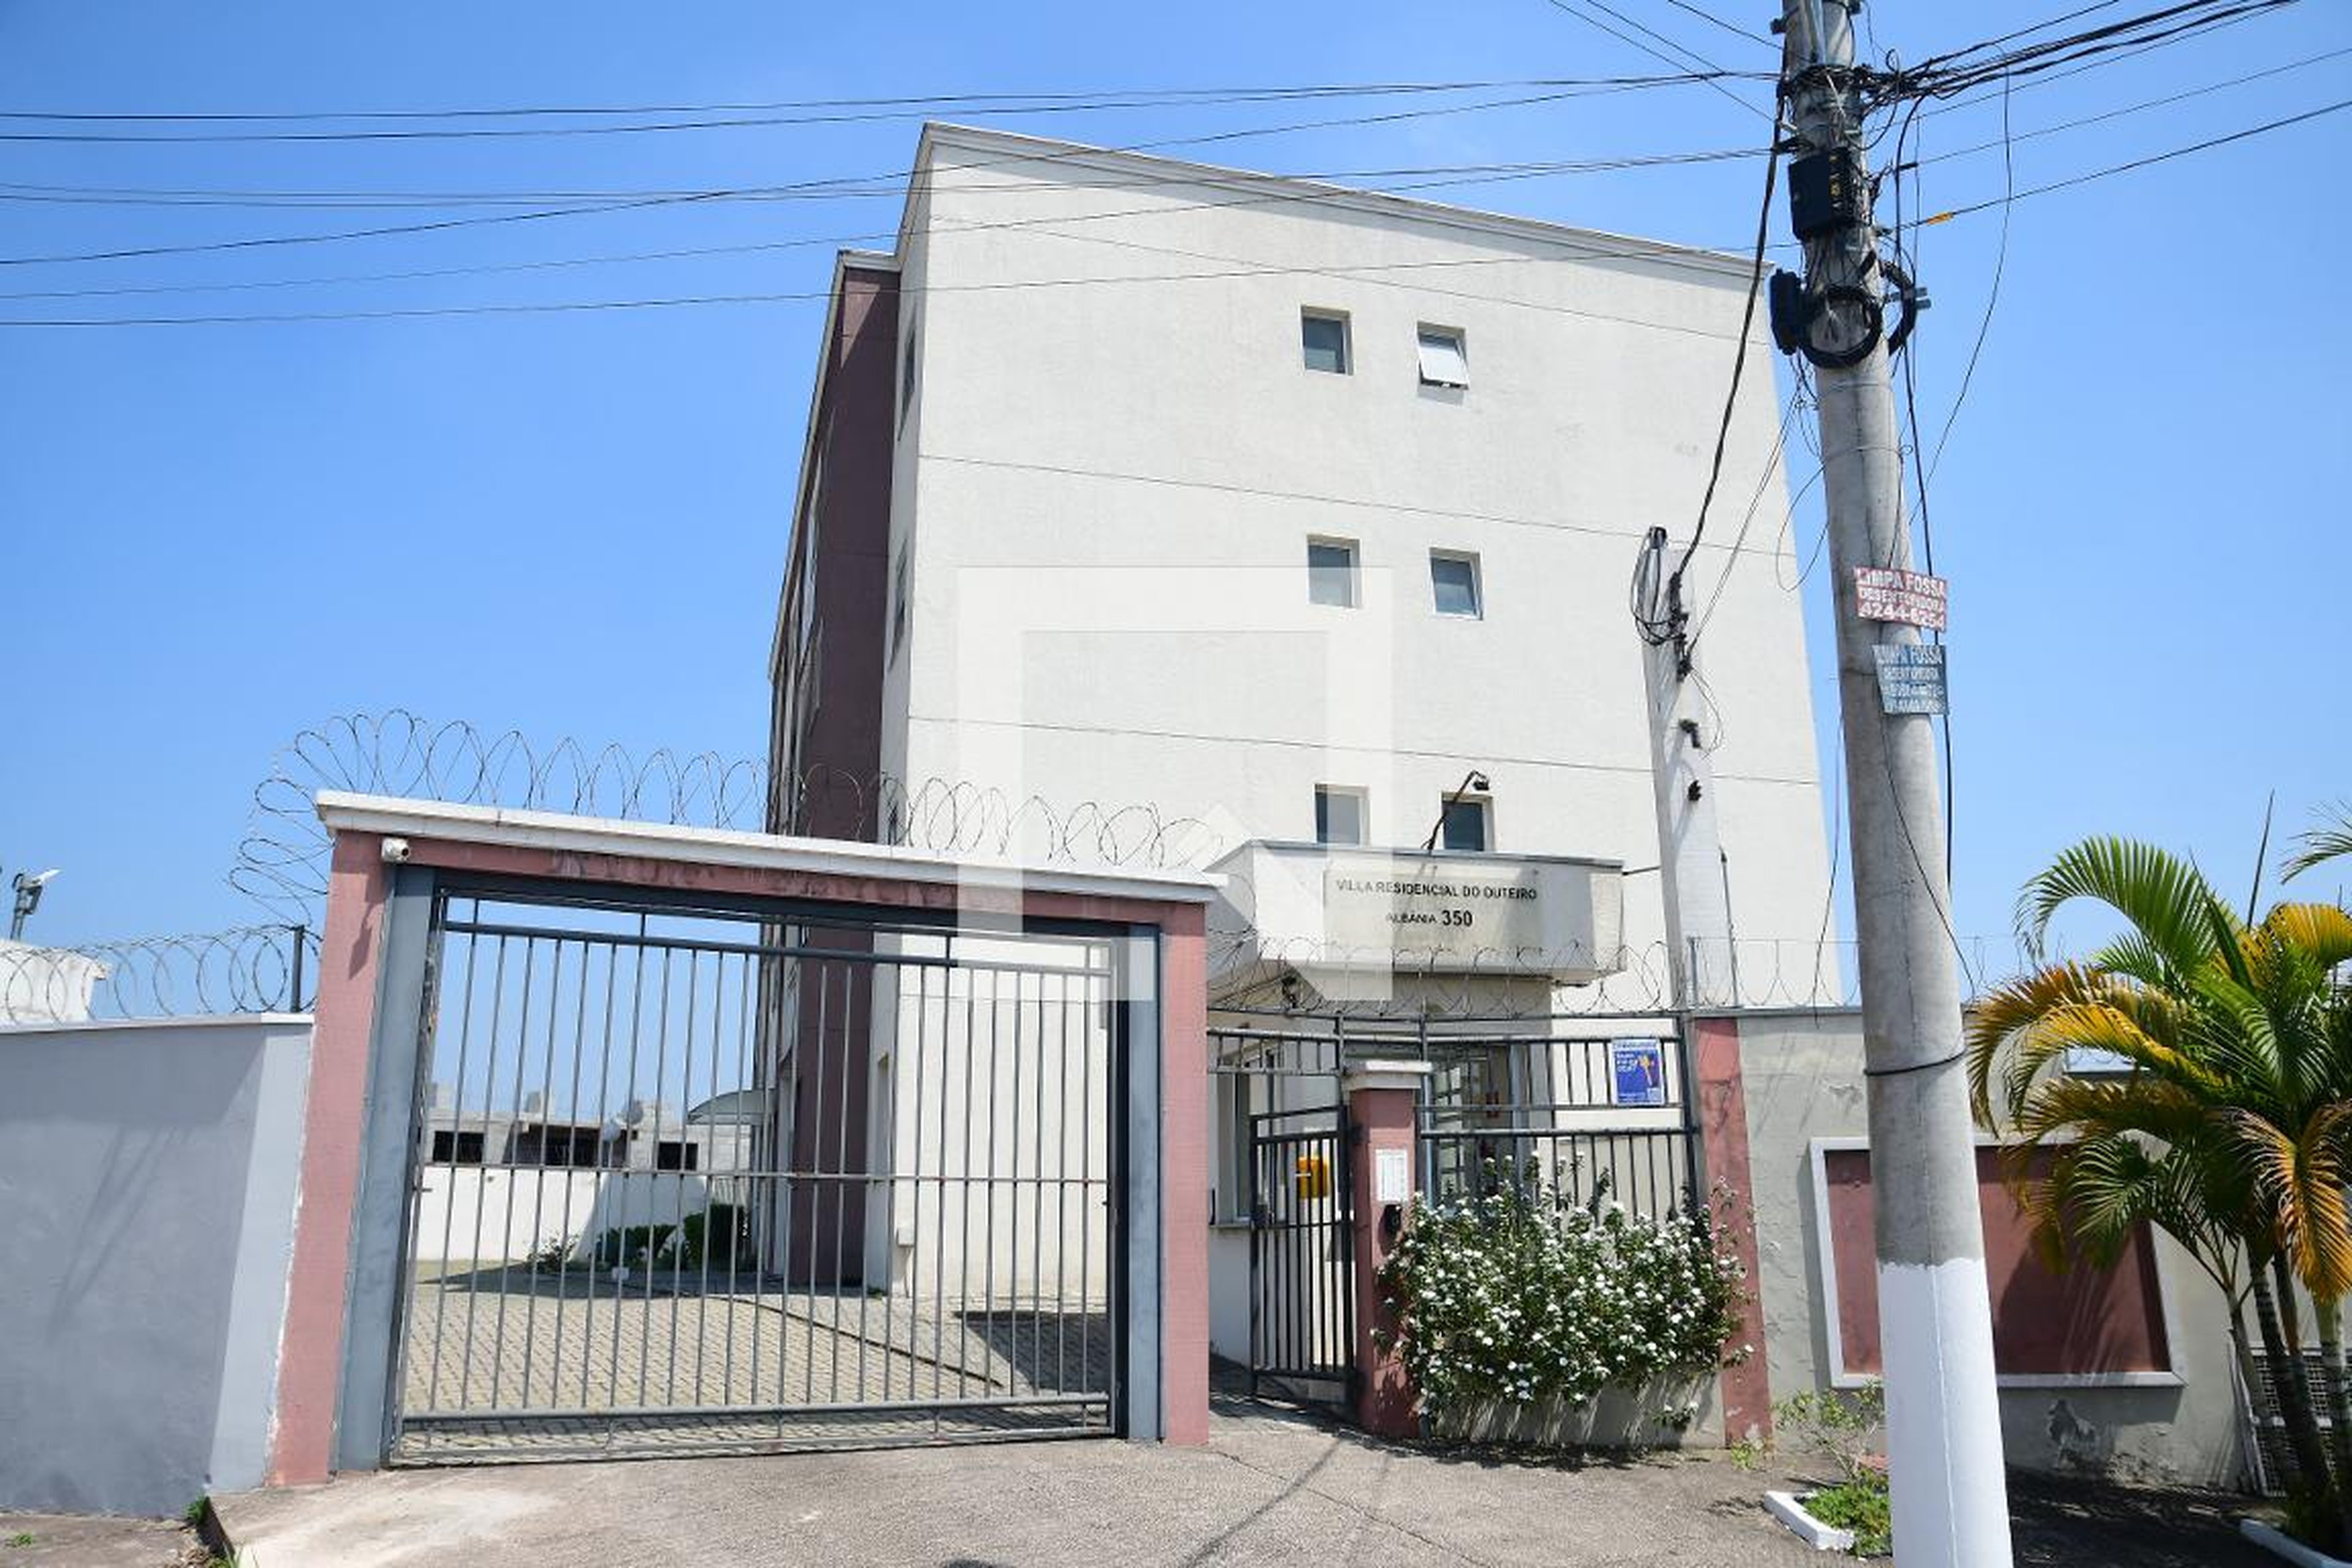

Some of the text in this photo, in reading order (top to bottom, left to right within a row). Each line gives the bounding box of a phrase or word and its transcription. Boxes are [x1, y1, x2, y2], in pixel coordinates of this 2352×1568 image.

[1905, 573, 1947, 597] FOSSA
[1336, 879, 1537, 900] VILLA RESIDENCIAL DO OUTEIRO
[1441, 910, 1473, 927] 350
